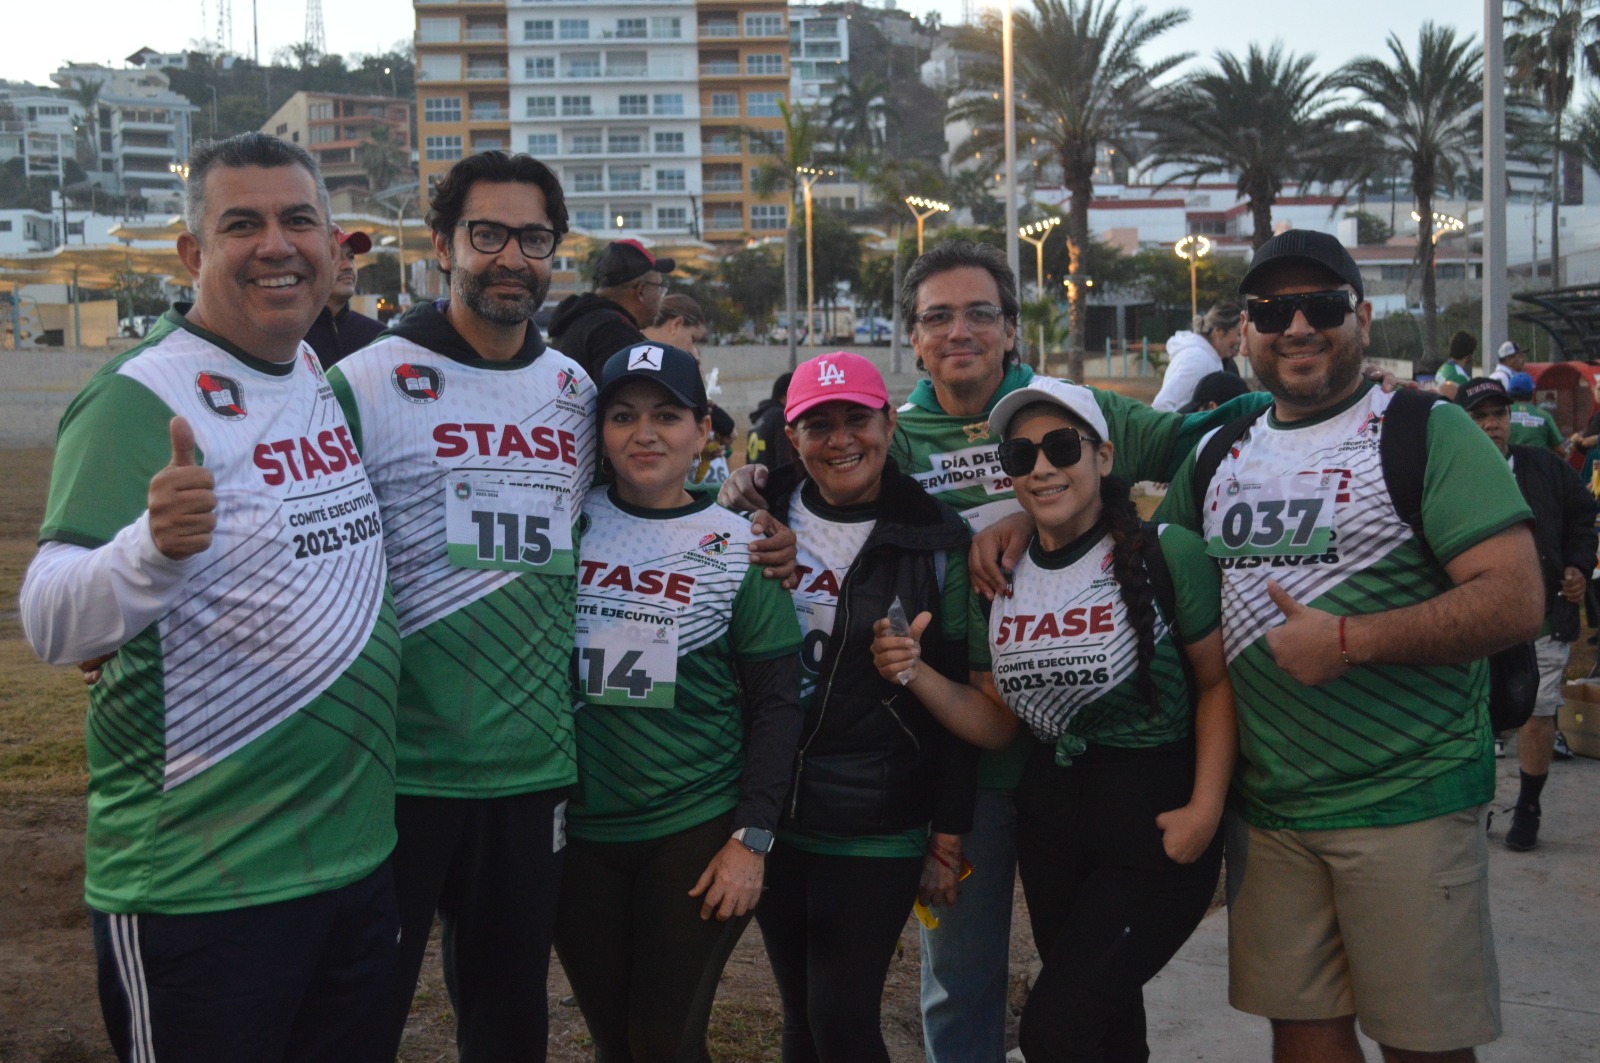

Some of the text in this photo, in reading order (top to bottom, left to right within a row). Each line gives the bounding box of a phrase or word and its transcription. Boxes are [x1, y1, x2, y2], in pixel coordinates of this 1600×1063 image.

[817, 360, 845, 387] LA
[253, 425, 361, 486] STASE
[432, 423, 577, 467] STASE
[941, 455, 969, 470] DÍA
[289, 493, 374, 527] COMITÉ EJECUTIVO
[1221, 498, 1324, 549] 037
[292, 512, 381, 559] 2023-2026
[471, 510, 553, 565] 115
[683, 555, 711, 566] DEPORTES
[687, 551, 719, 564] SECRETARÍA
[601, 607, 674, 626] EJECUTIVO
[995, 602, 1115, 646] STASE
[997, 654, 1107, 674] COMITÉ EJECUTIVO
[999, 667, 1109, 694] 2023-2026
